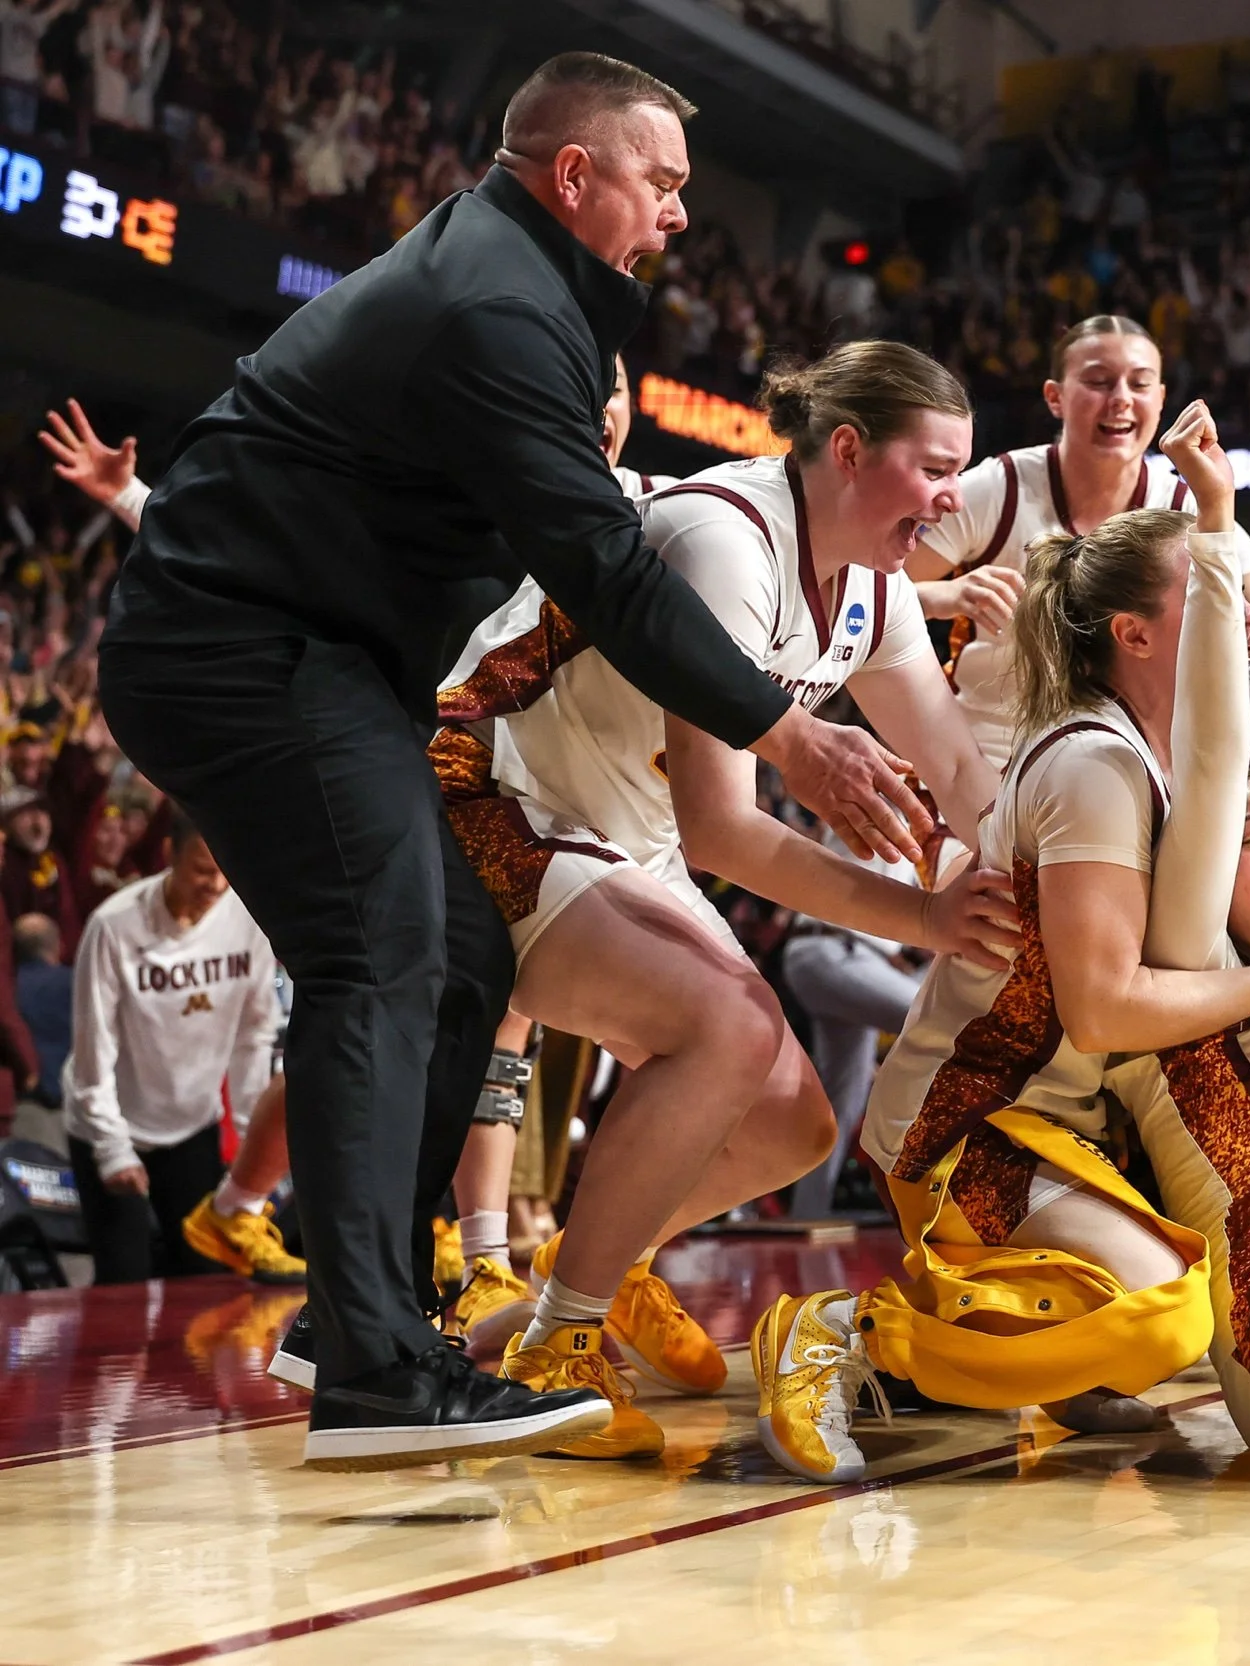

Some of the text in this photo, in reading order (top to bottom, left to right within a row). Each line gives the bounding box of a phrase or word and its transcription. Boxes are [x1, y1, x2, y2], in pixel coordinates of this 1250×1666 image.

[138, 950, 252, 992] LOCK IT IN
